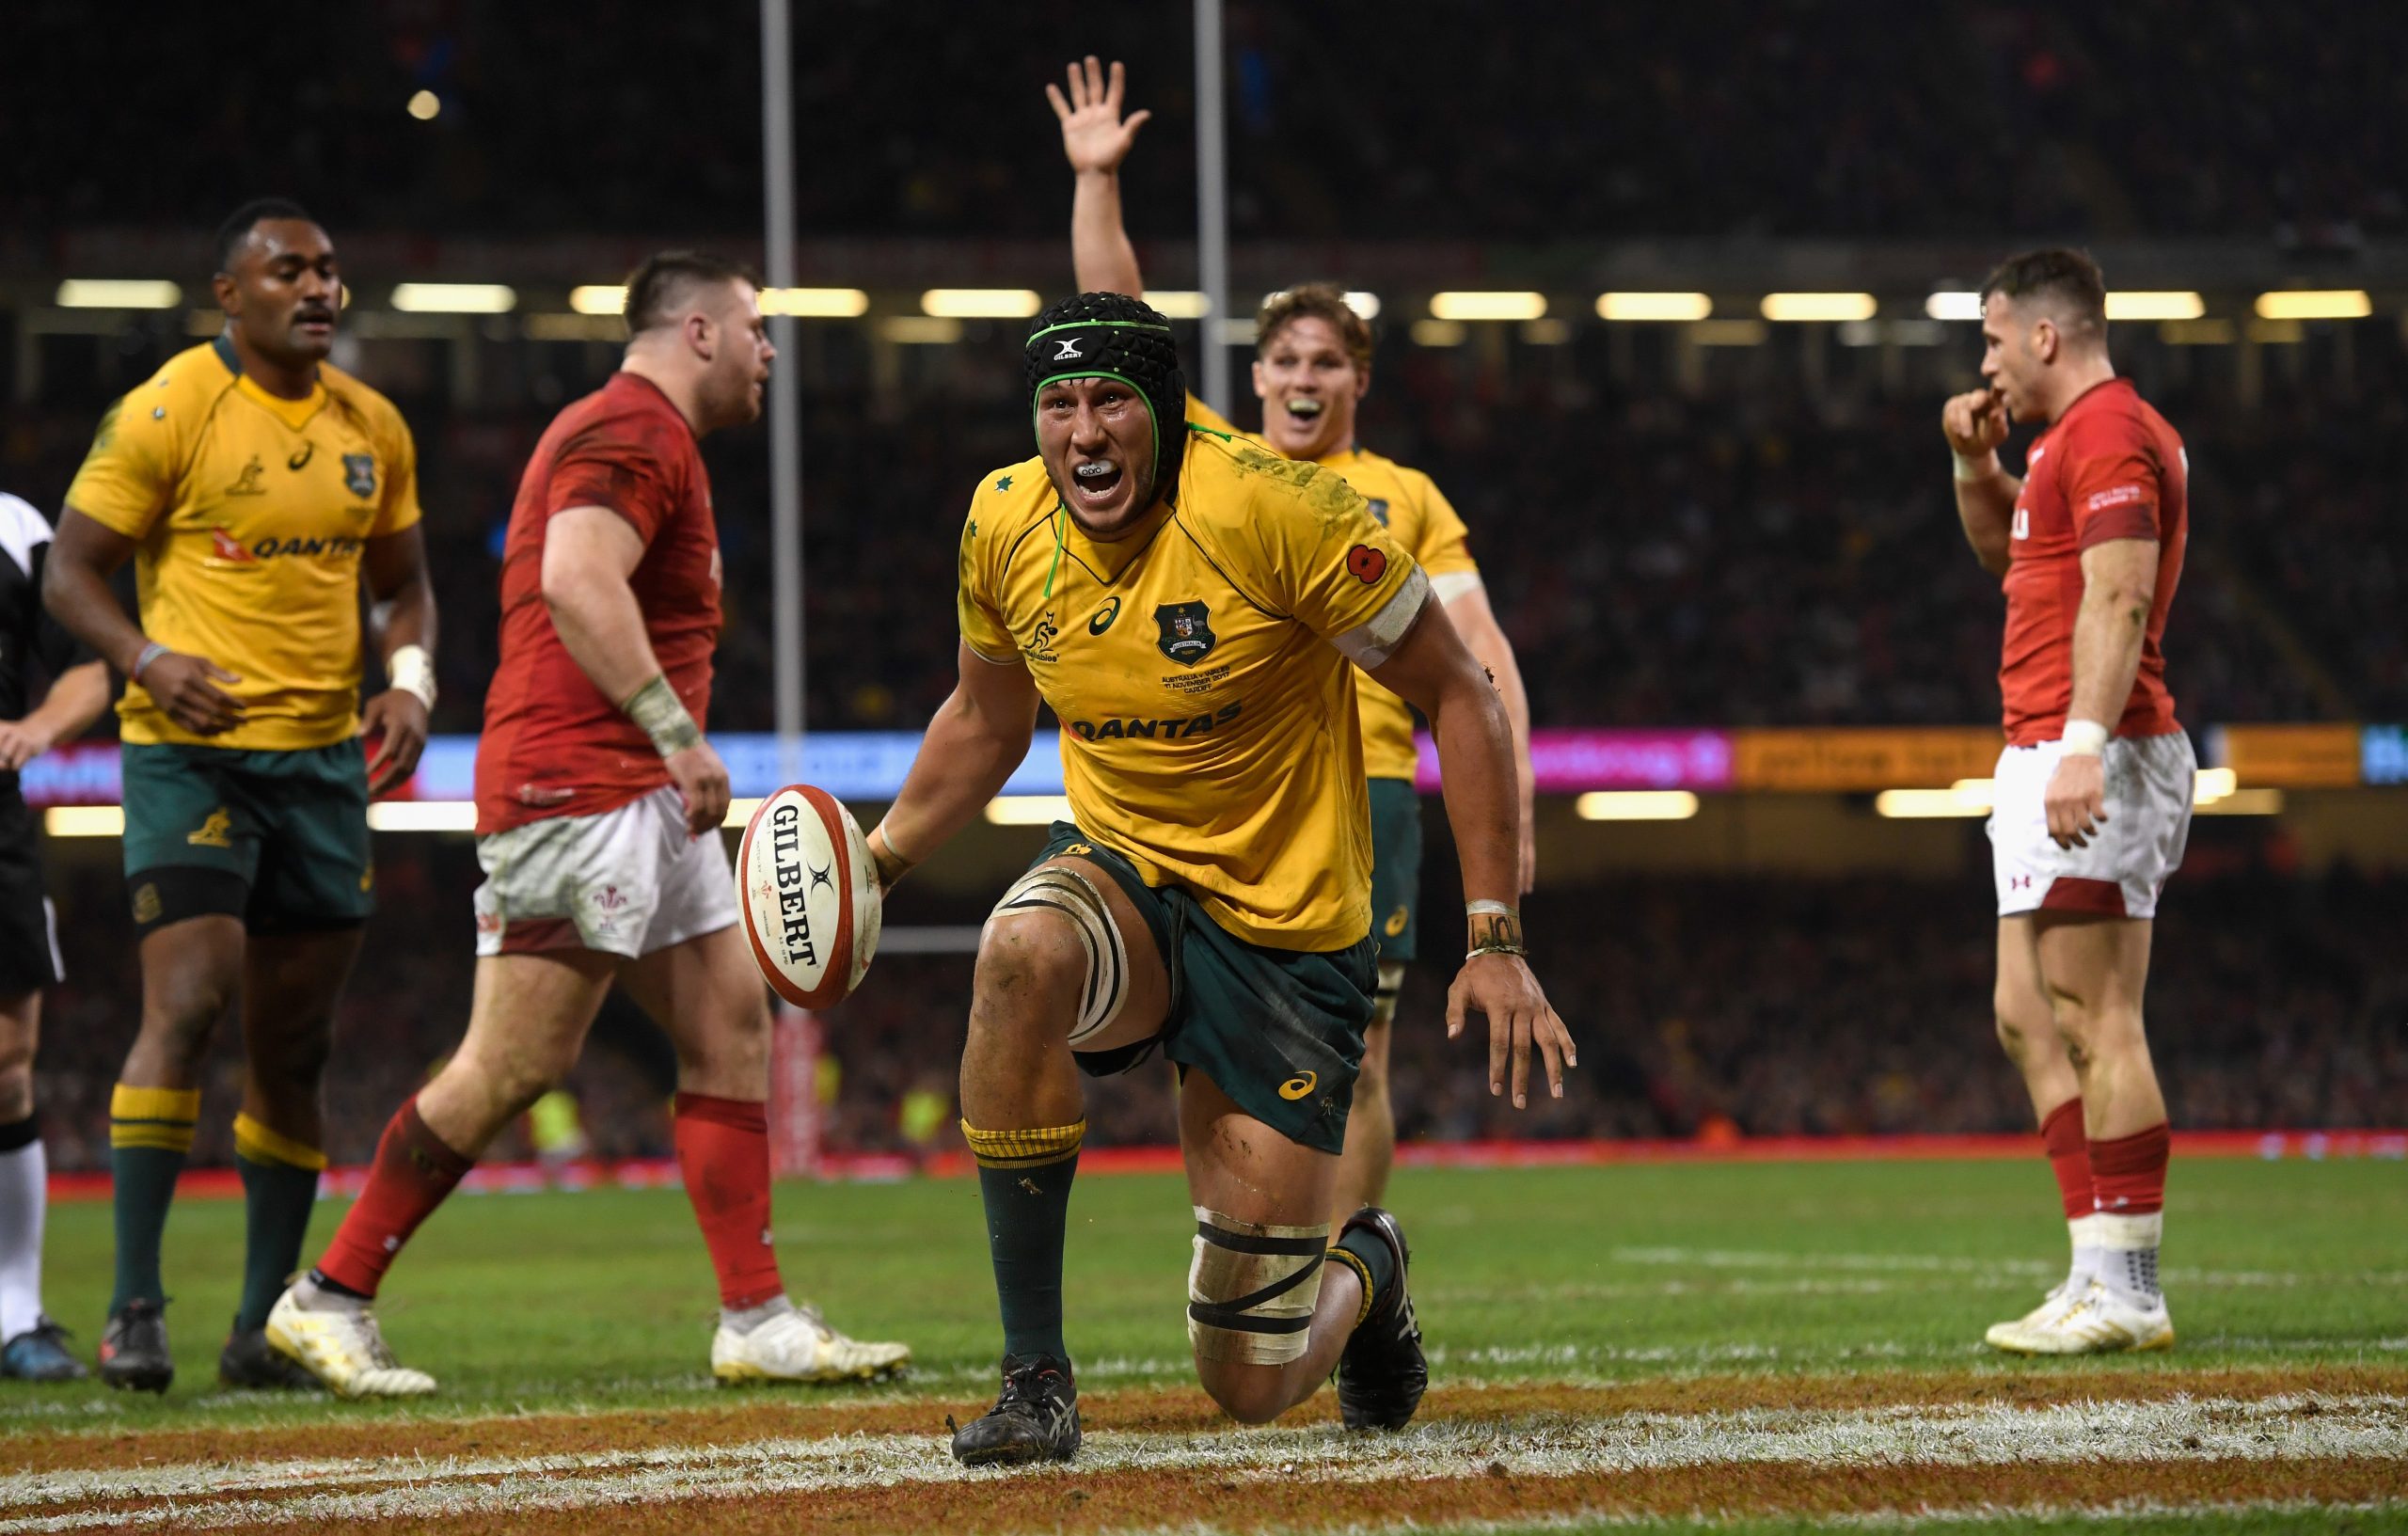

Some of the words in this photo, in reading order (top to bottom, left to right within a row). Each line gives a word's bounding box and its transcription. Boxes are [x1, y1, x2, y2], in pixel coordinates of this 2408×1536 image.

[1054, 353, 1083, 361] GILBERT
[1173, 641, 1201, 649] AUSTRALIA
[1162, 673, 1198, 683] AUSTRALIA
[1173, 677, 1212, 689] NOVEMBER
[1212, 672, 1230, 682] 2017
[1184, 683, 1212, 694] CARDIFF
[1071, 699, 1243, 743] QANTAS
[773, 804, 817, 968] GILBERT
